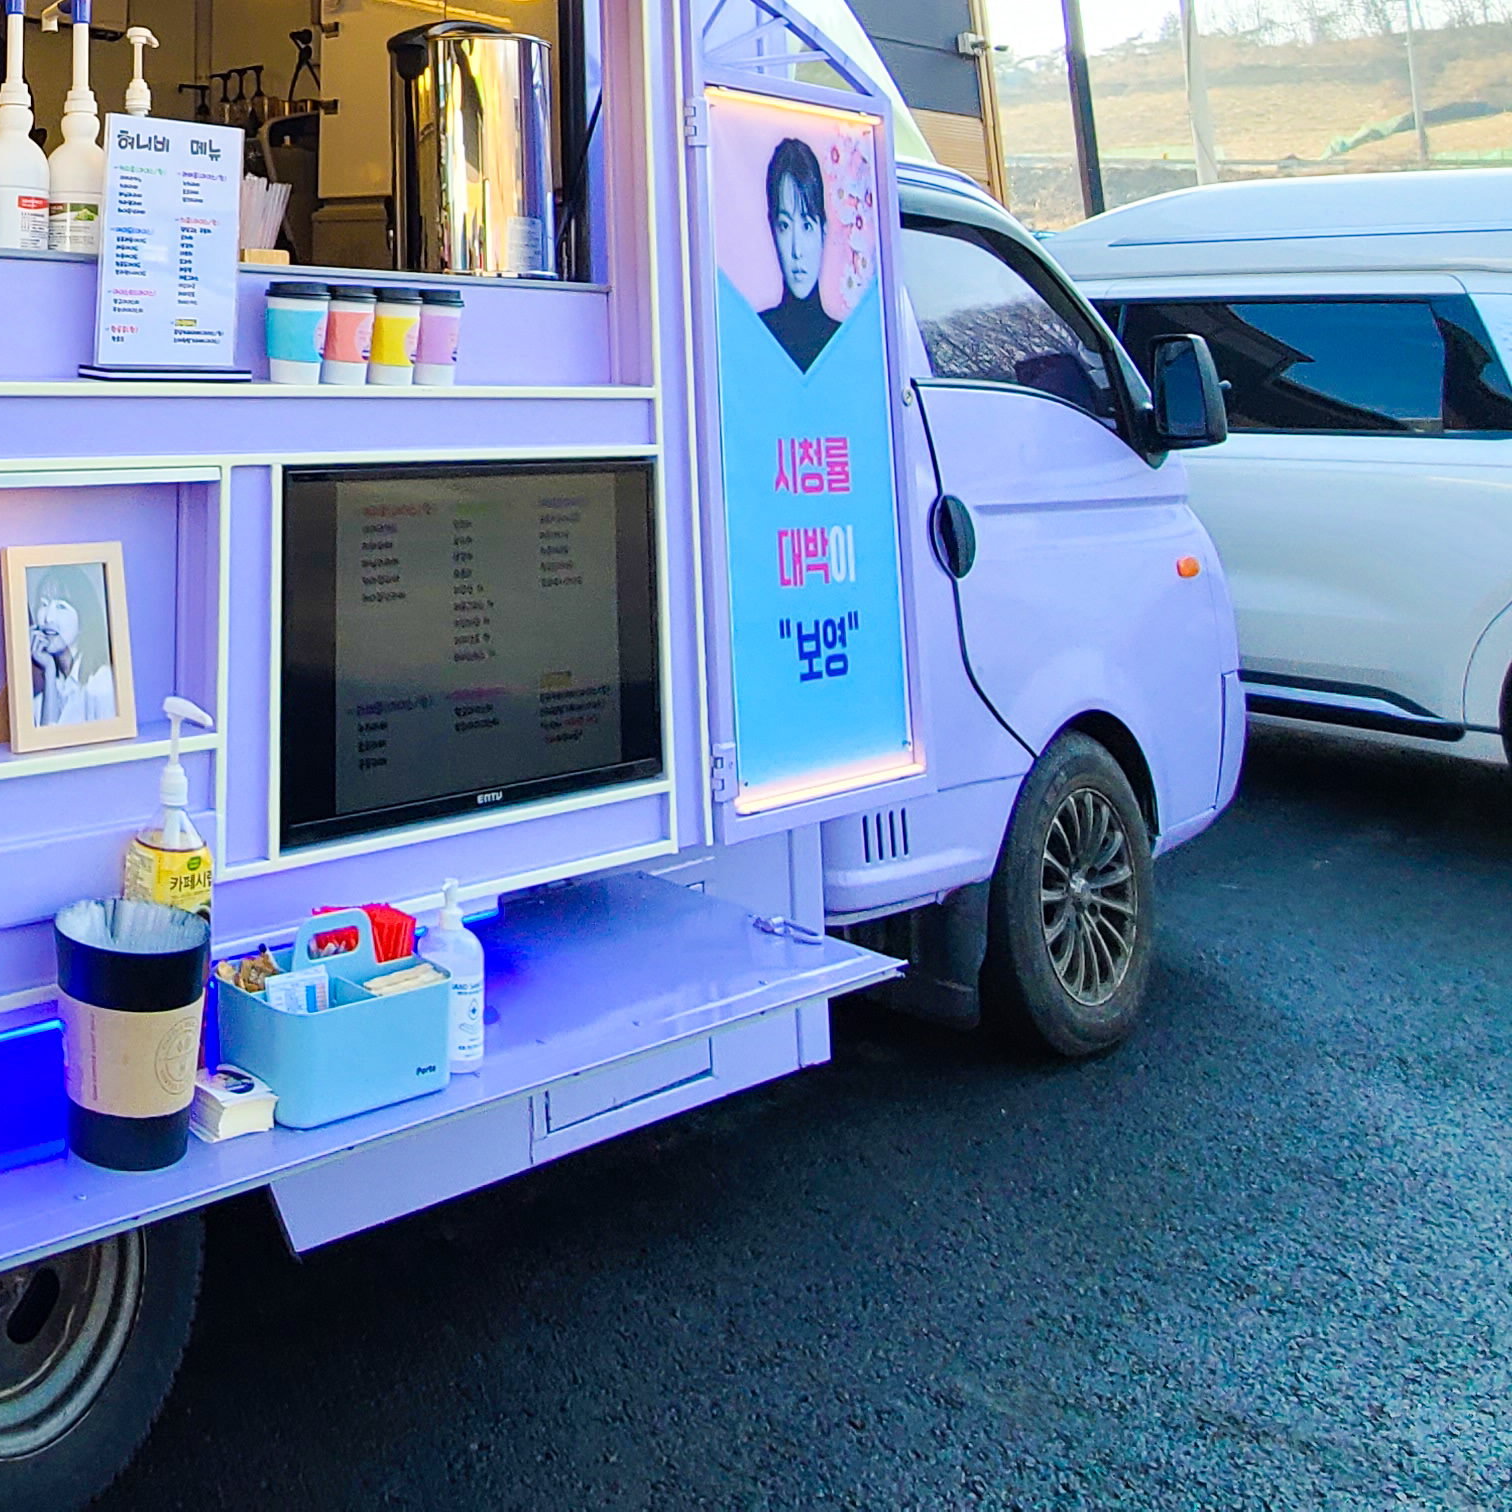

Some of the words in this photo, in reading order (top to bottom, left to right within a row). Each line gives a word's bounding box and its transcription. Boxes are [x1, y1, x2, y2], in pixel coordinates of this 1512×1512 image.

[117, 130, 170, 153] 허니비
[190, 139, 221, 162] 메뉴
[775, 437, 851, 494] 시청률
[777, 525, 856, 587] 대박이
[779, 610, 859, 682] "보영"
